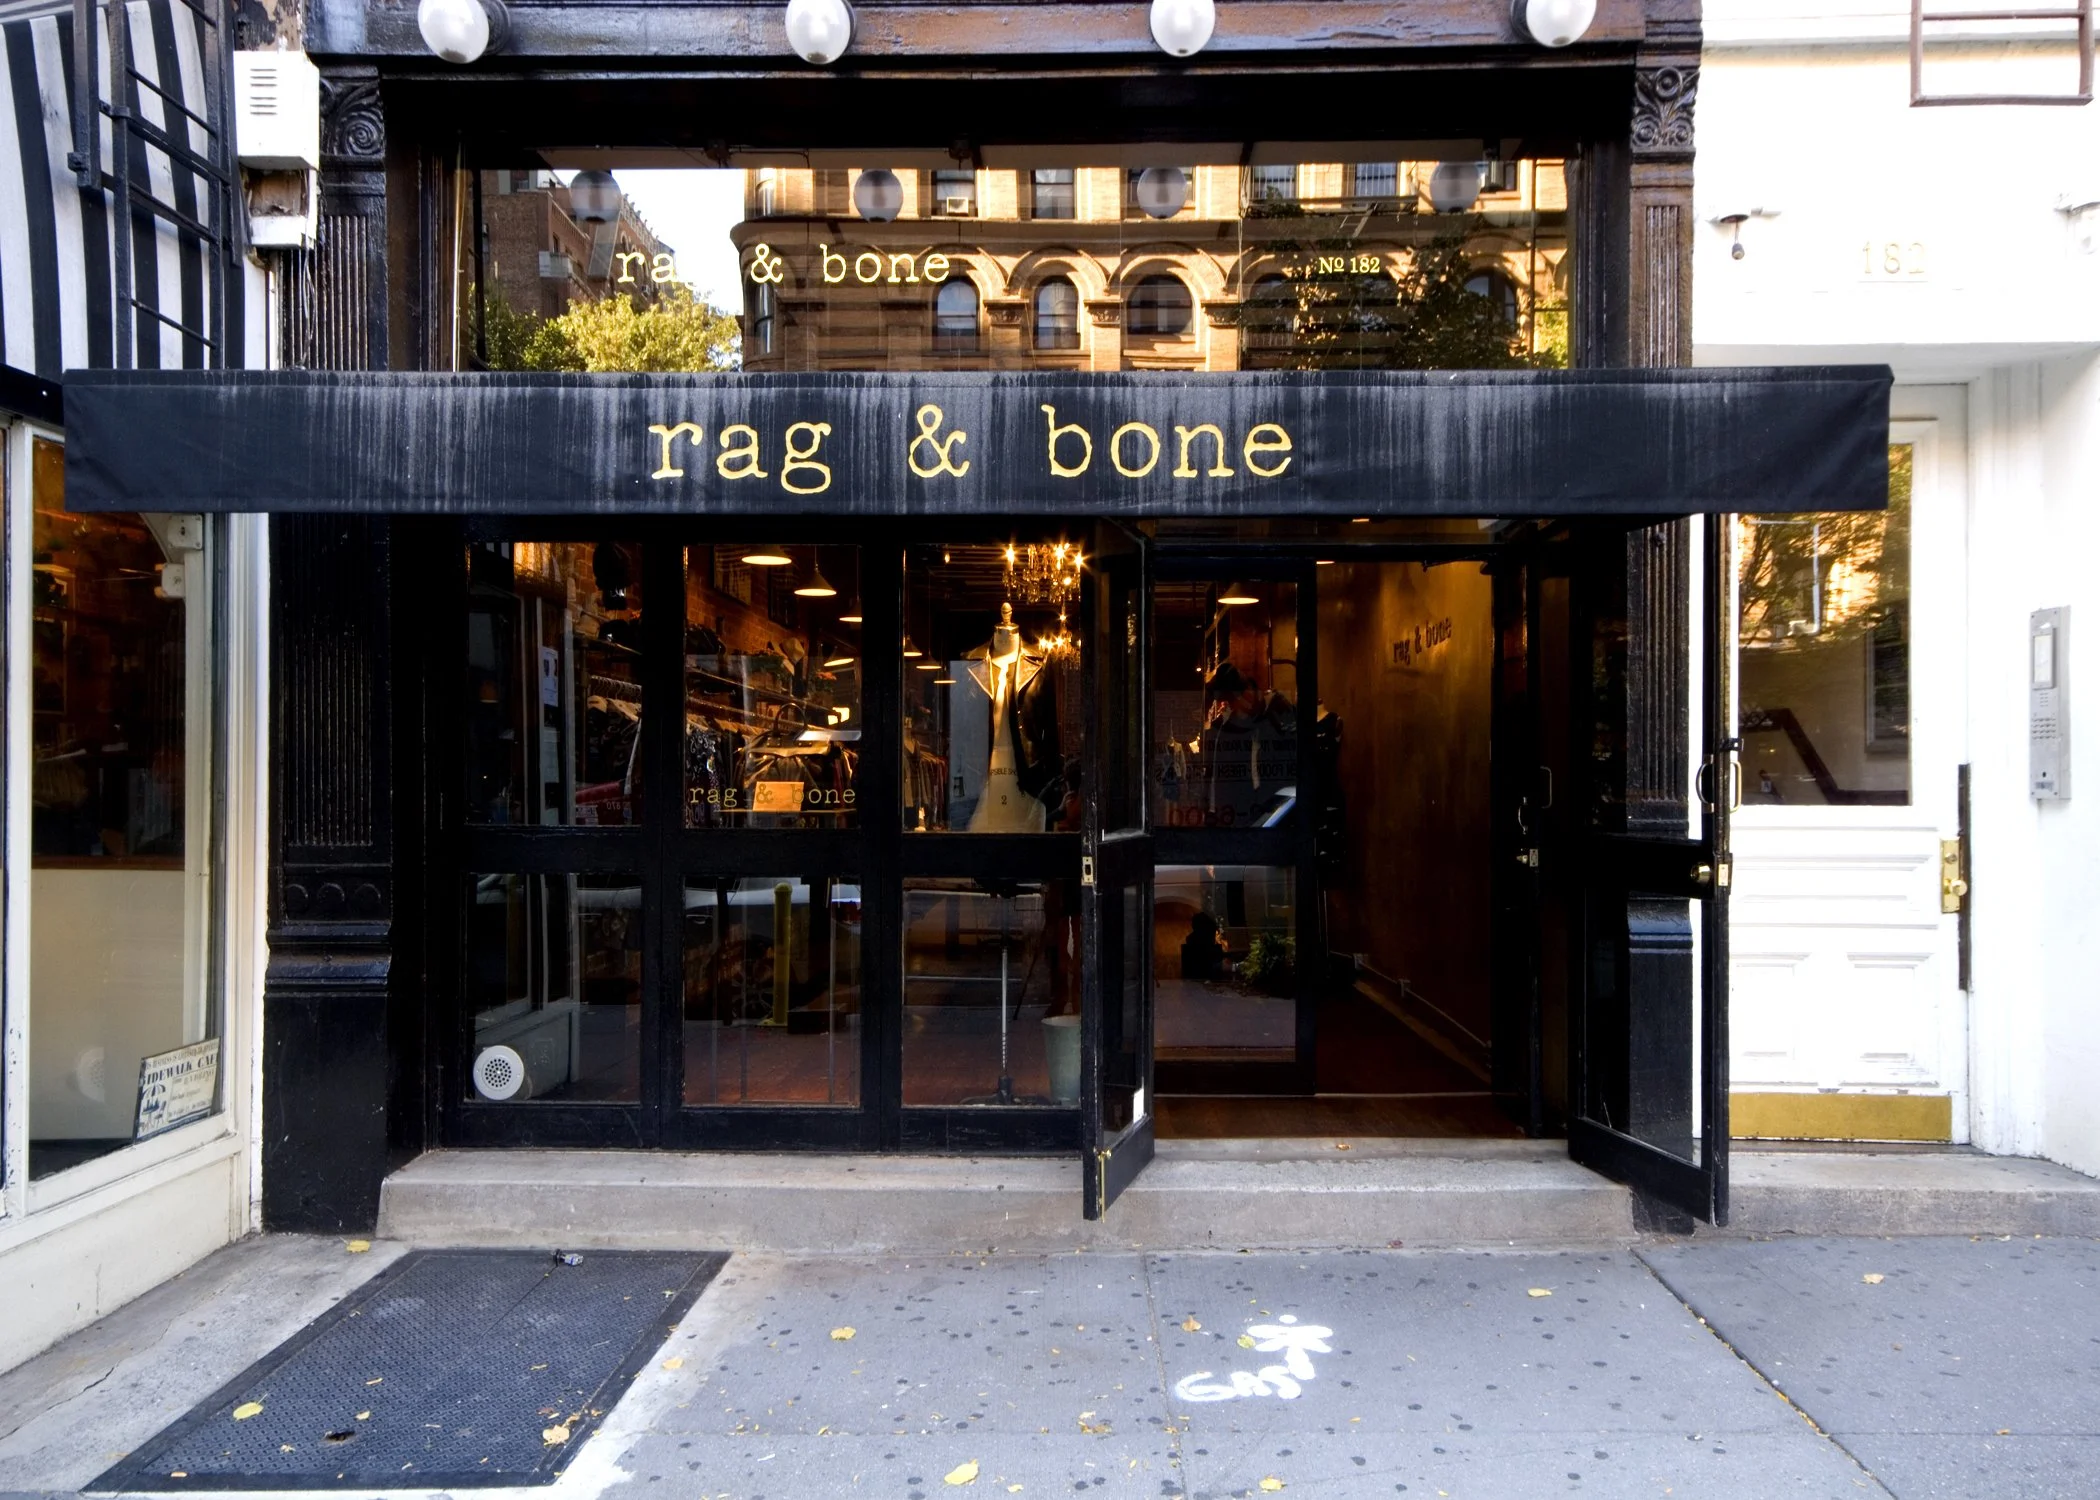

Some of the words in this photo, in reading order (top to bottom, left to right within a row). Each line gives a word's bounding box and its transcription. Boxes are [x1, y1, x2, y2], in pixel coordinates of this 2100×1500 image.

[616, 251, 699, 291] ra
[750, 242, 784, 284] &
[820, 243, 951, 284] bone
[1350, 257, 1380, 273] 182
[1862, 241, 1925, 274] 182
[648, 422, 831, 495] rag
[908, 404, 970, 478] &
[1042, 404, 1293, 478] bone
[1393, 639, 1411, 666] rag
[1415, 624, 1422, 655] &
[1425, 616, 1452, 649] bone
[690, 787, 737, 808] rag
[755, 783, 774, 803] &
[791, 784, 856, 804] bone
